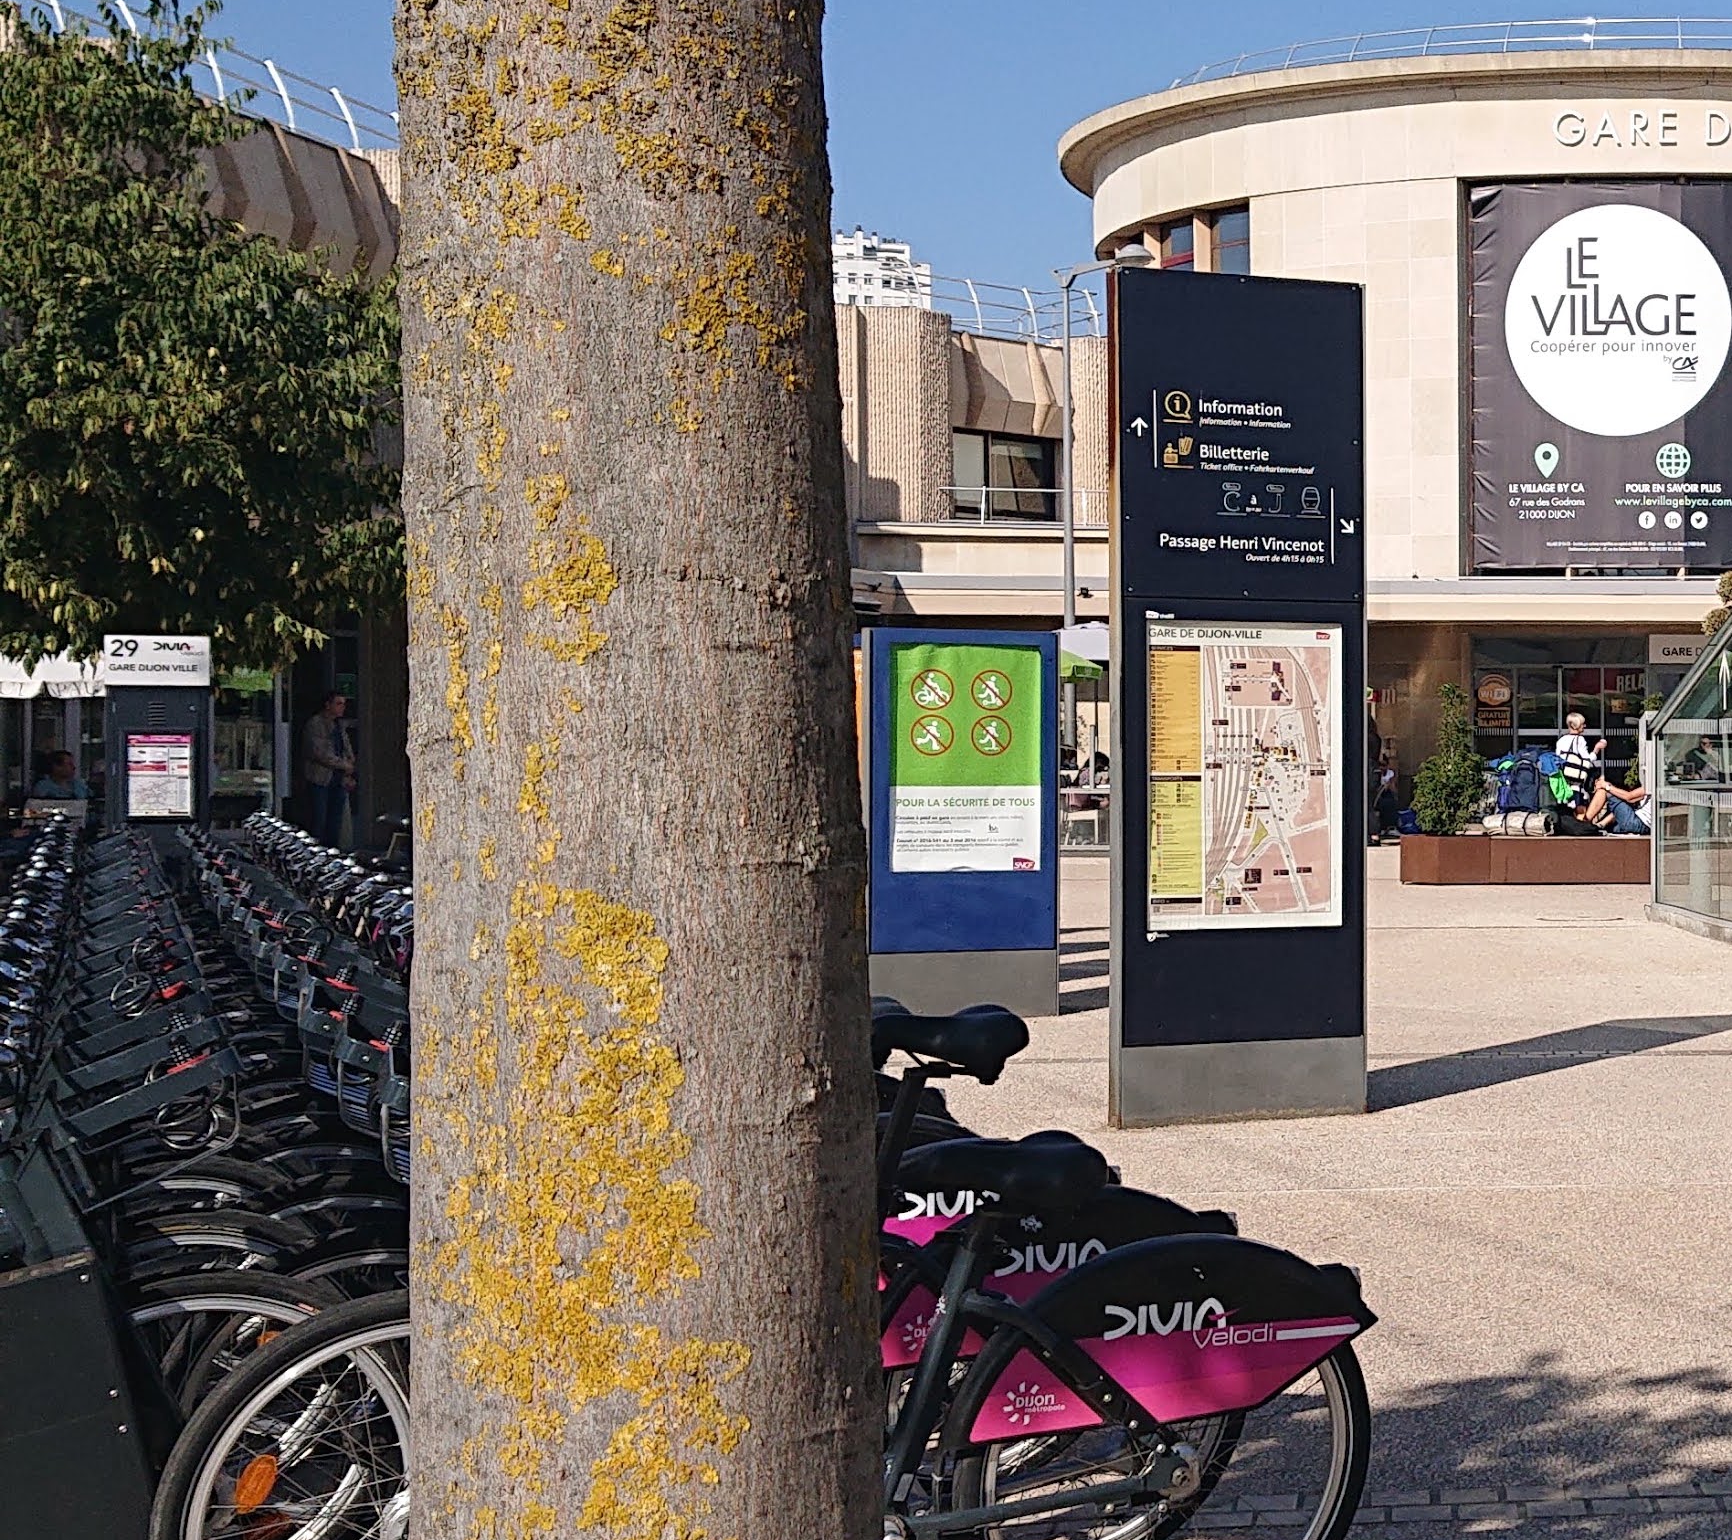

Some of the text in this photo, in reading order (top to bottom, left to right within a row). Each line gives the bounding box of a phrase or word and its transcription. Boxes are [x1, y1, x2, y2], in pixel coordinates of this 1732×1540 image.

[1552, 109, 1678, 148] GARE
[1567, 237, 1599, 288] LE
[1531, 284, 1697, 336] VILLAGE
[1530, 339, 1697, 355] Coopérer pour innover
[1198, 399, 1283, 417] Information
[1200, 417, 1291, 429] Information Information
[1200, 444, 1269, 461] Billetterie
[1200, 462, 1222, 471] Ticket
[1223, 463, 1243, 471] office
[1509, 483, 1585, 493] LE VILLAGE BY CA
[1625, 483, 1722, 493] POUR EN SAVOIR PLUS
[1509, 497, 1586, 507] 67 rue des Godrans
[1615, 495, 1732, 509] www.levillagebyca.com
[1518, 509, 1576, 520] 21000 DIJON
[1159, 533, 1325, 553] Passage Henri Vincenot
[1245, 554, 1270, 562] Ouvert
[1271, 555, 1280, 563] de
[1281, 555, 1299, 563] 4h15
[1149, 628, 1262, 639] GARE DE DIJON-VILLE
[110, 639, 139, 657] 29
[1662, 647, 1692, 656] GARE
[108, 663, 198, 672] GARE DIJON VILLE
[896, 798, 924, 807] POUR
[928, 798, 940, 807] LA
[993, 798, 1006, 807] DE
[1009, 798, 1036, 807] TOUS
[1104, 1297, 1228, 1341] DIVIA
